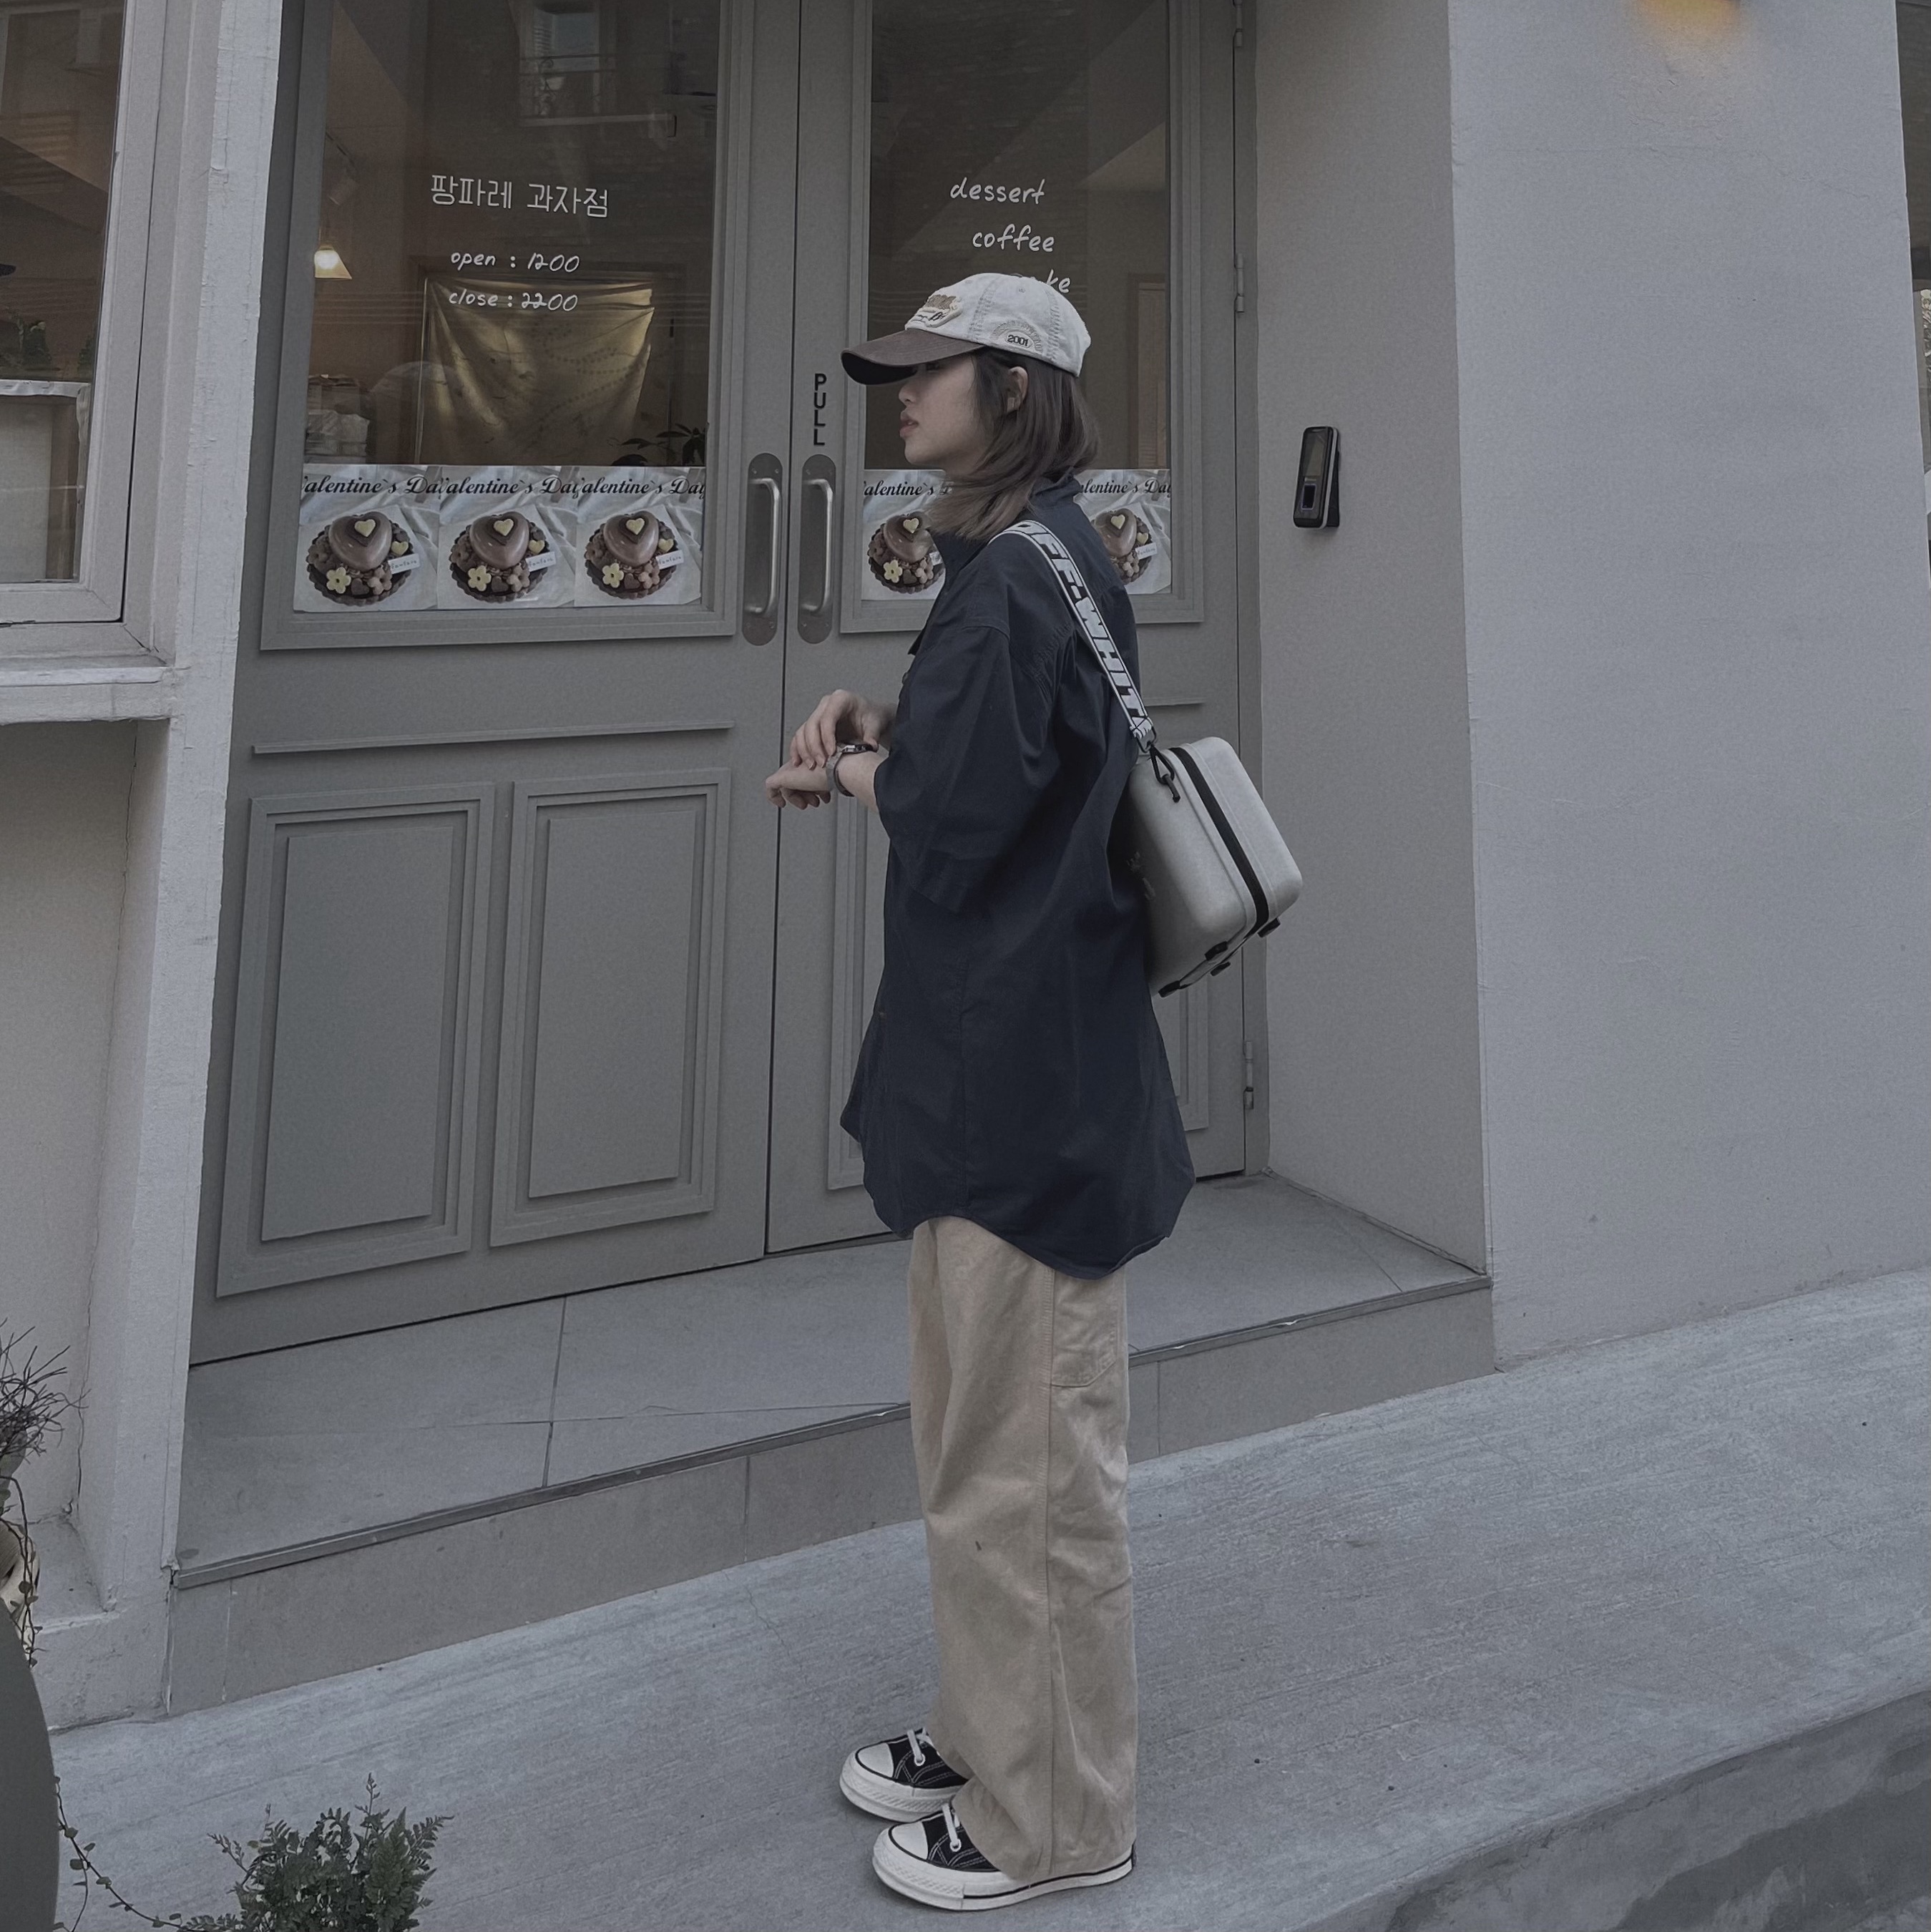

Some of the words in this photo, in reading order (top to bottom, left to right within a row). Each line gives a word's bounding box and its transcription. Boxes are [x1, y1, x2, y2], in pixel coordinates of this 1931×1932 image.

[431, 175, 512, 210] 팡파레
[527, 182, 608, 218] 과자점
[949, 176, 1045, 205] dessert
[972, 223, 1055, 253] coffee
[450, 252, 496, 271] open
[527, 252, 580, 273] 1200
[448, 288, 499, 307] close
[521, 292, 579, 312] 2200
[1007, 333, 1030, 347] 2001
[813, 373, 828, 447] PULL
